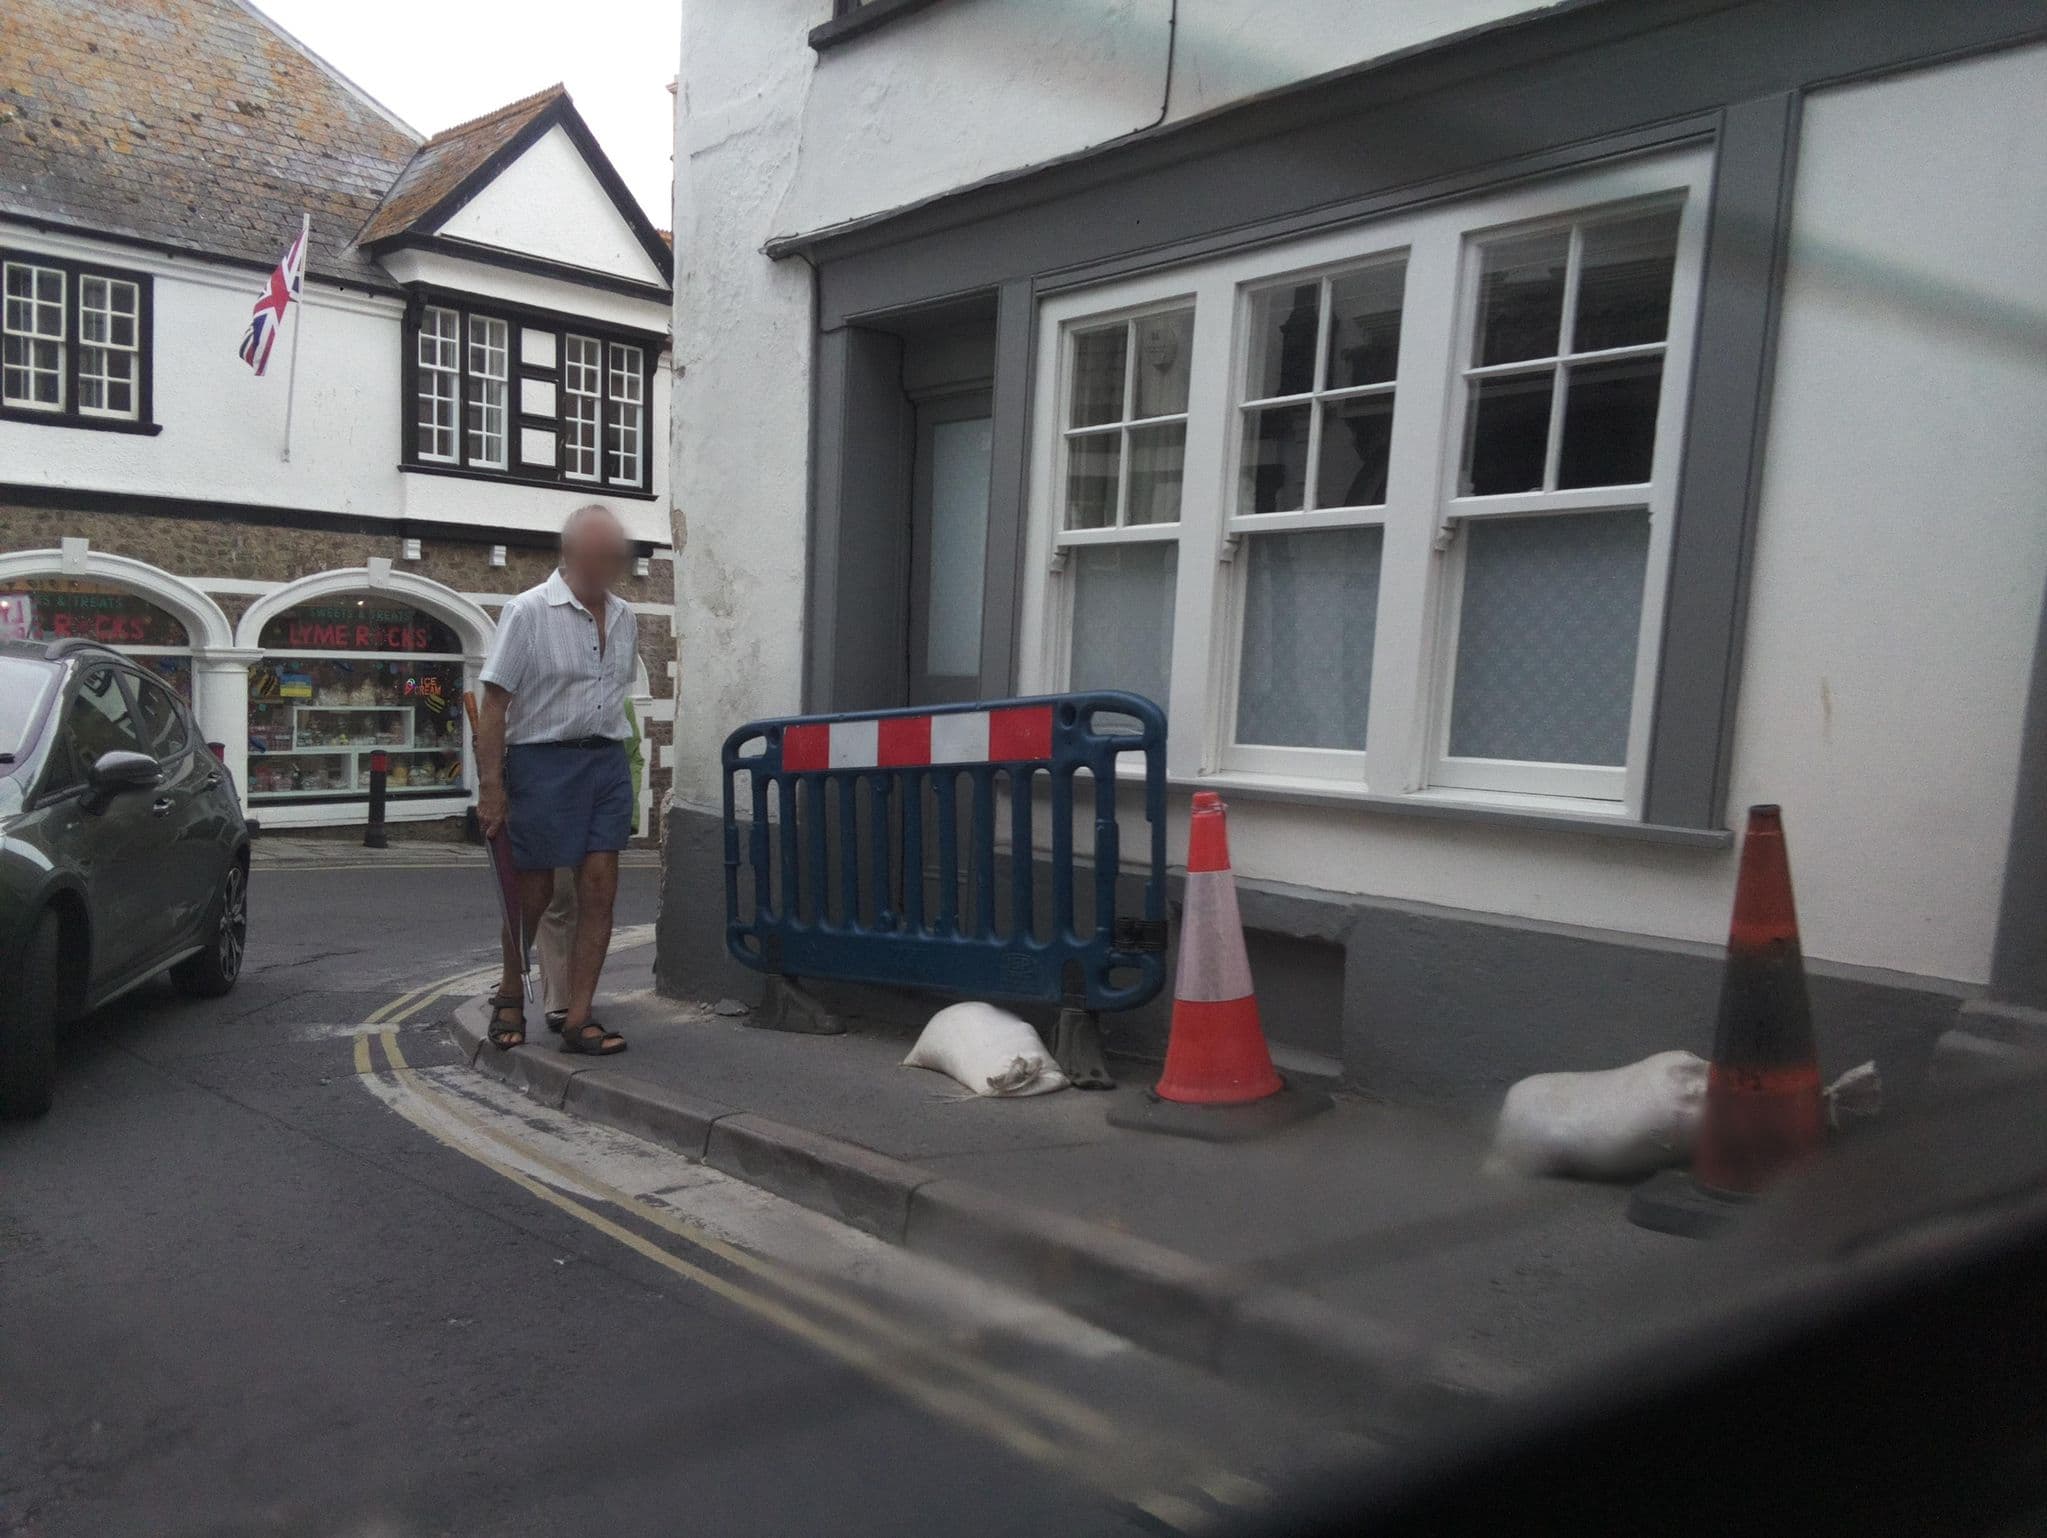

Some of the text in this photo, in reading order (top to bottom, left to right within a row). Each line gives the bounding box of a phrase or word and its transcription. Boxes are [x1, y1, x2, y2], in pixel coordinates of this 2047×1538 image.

[289, 623, 348, 647] LYME
[420, 677, 437, 685] ICE
[415, 684, 442, 696] CREAM
